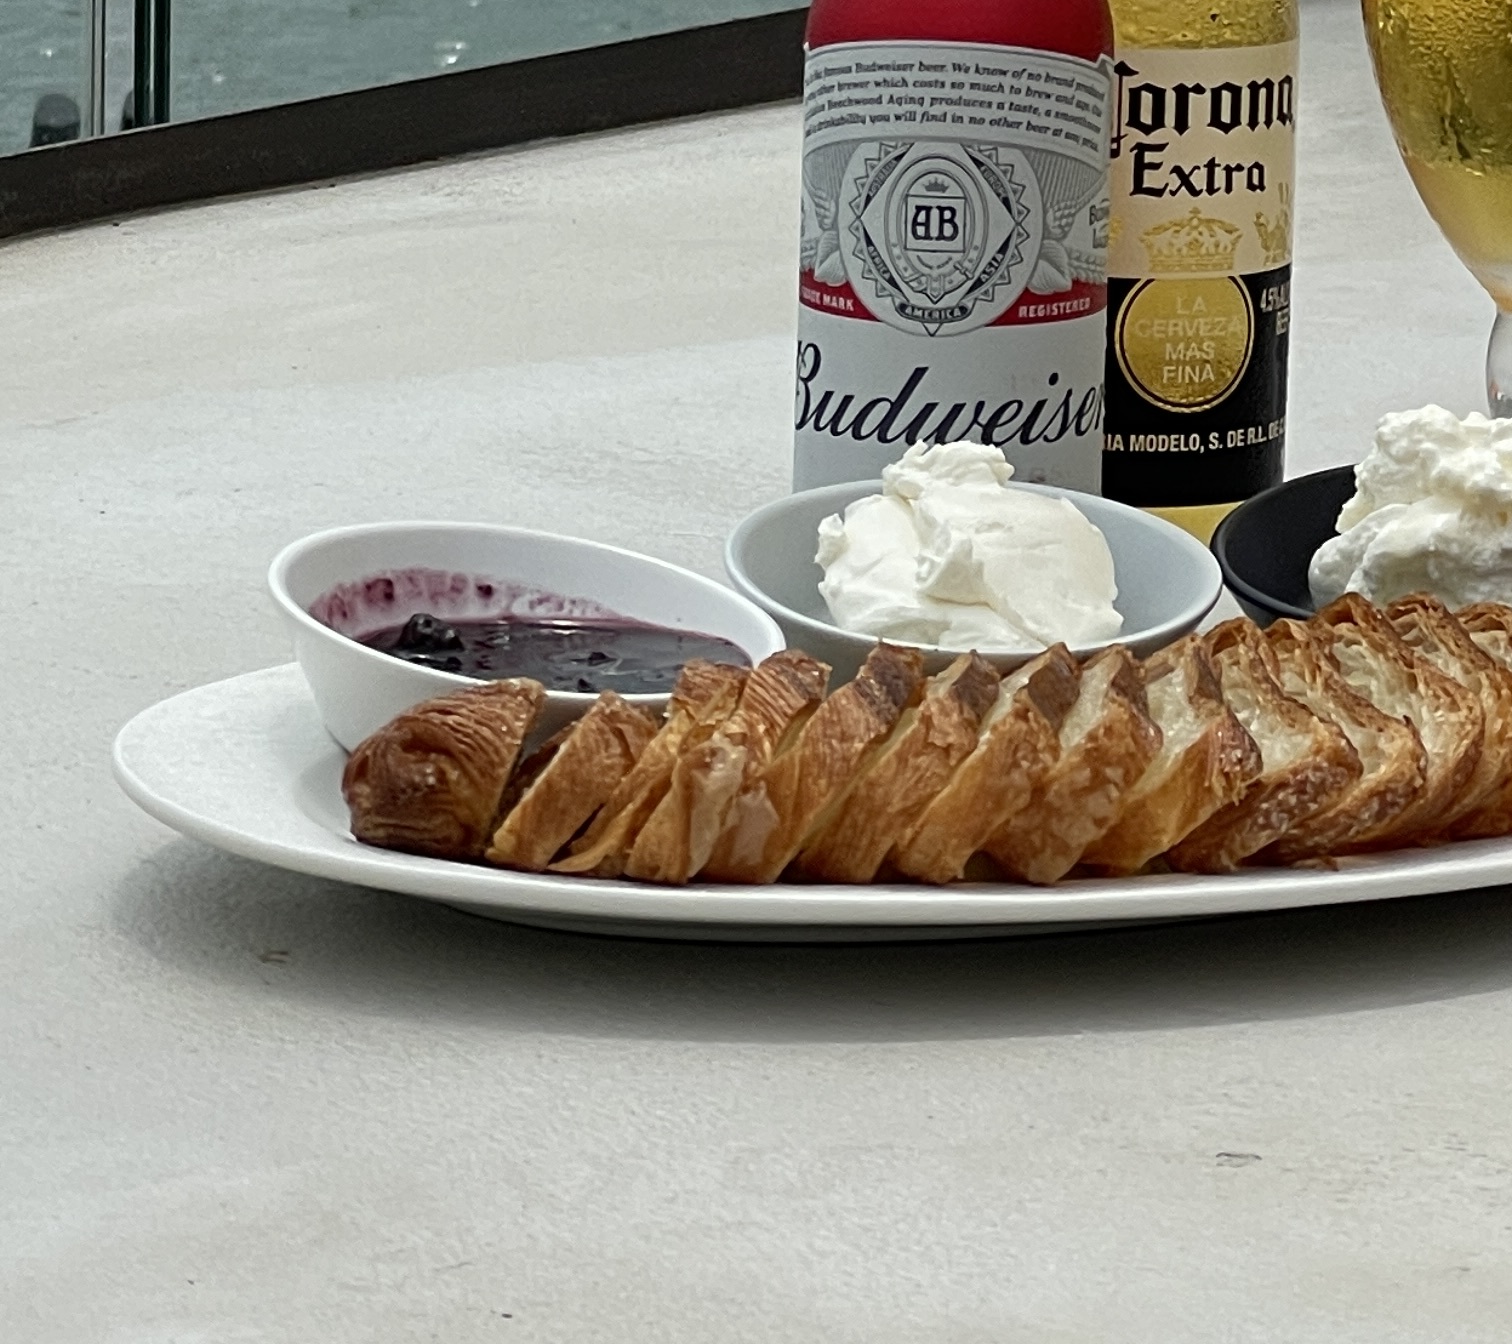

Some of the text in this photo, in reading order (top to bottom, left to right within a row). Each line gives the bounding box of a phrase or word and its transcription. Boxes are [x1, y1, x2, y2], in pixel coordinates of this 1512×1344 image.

[951, 62, 971, 74] We
[974, 63, 1010, 77] know
[1011, 68, 1027, 81] of
[1026, 72, 1042, 82] no
[873, 76, 909, 89] which
[912, 78, 946, 89] costs
[950, 81, 965, 90] so
[969, 81, 1005, 94] much
[1009, 84, 1022, 96] to
[1025, 86, 1053, 100] brew
[887, 94, 926, 108] Aging
[929, 95, 993, 110] produces
[996, 101, 1005, 111] a
[1008, 101, 1042, 118] taste,
[1044, 108, 1053, 118] a
[868, 114, 891, 125] you
[893, 110, 917, 123] will
[919, 110, 947, 124] find
[950, 112, 964, 124] in
[968, 115, 986, 126] no
[988, 116, 1024, 130] other
[1025, 119, 1051, 135] beer
[1128, 141, 1267, 199] Extra
[979, 252, 1006, 284] ASIA
[822, 293, 855, 312] MARK
[903, 304, 962, 320] AMERICA
[1018, 297, 1092, 318] REGISTERED
[1175, 295, 1208, 316] LA
[1133, 317, 1244, 338] CERVEZA
[1164, 340, 1217, 362] MAS
[1161, 363, 1217, 385] FINA
[1129, 433, 1205, 454] MODELO,
[1208, 431, 1224, 450] S.
[1226, 428, 1245, 449] DE
